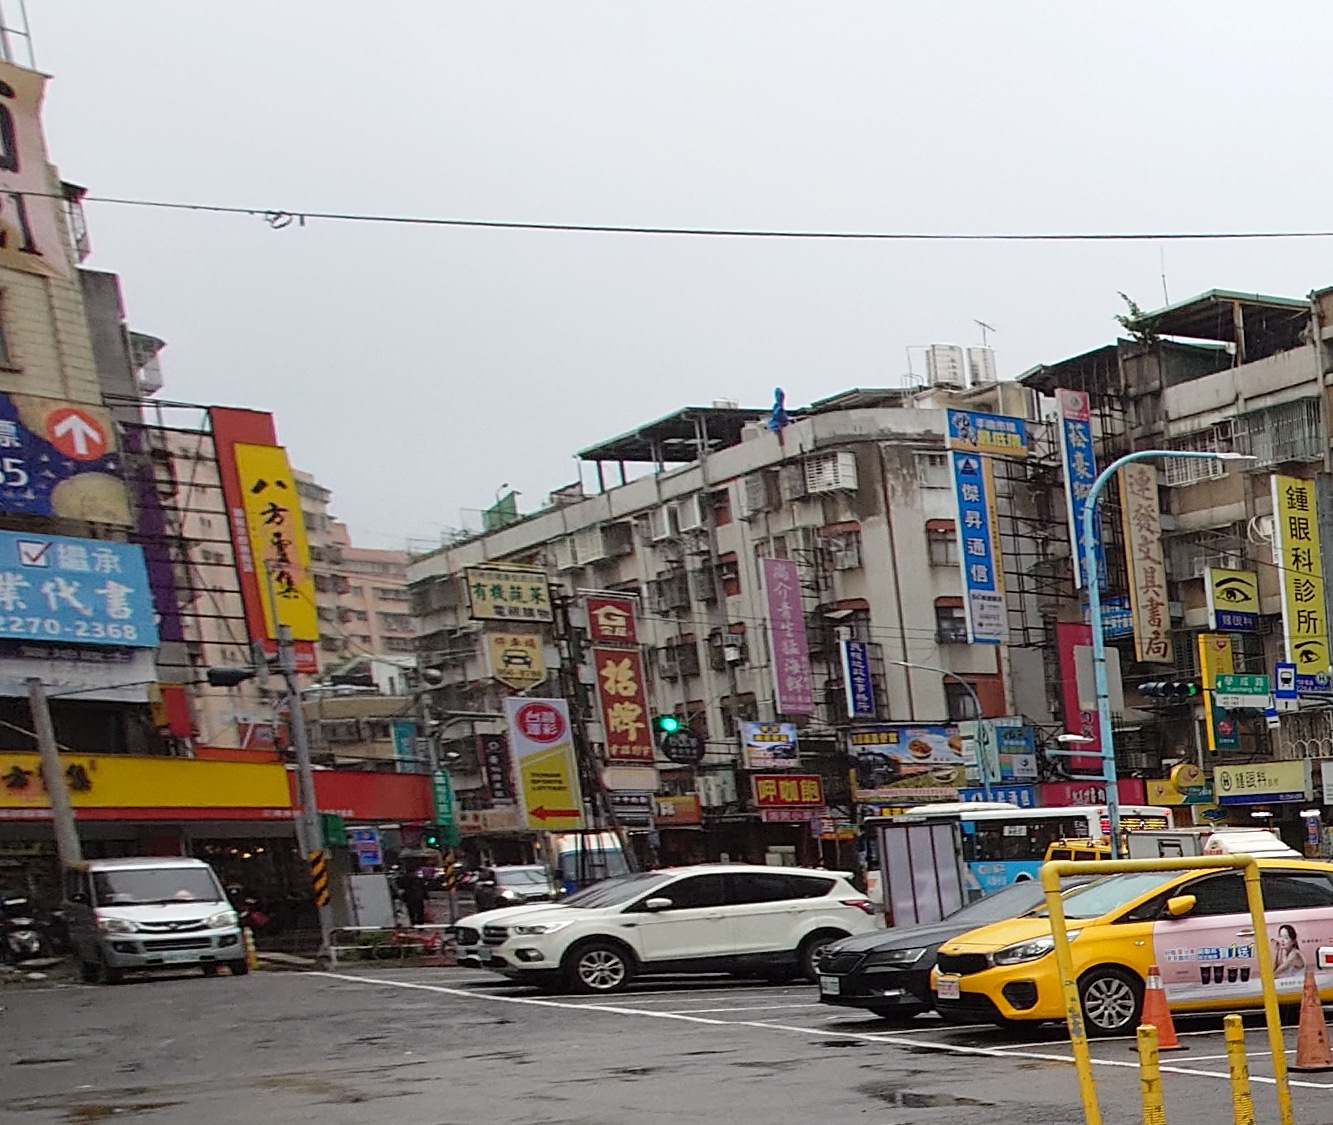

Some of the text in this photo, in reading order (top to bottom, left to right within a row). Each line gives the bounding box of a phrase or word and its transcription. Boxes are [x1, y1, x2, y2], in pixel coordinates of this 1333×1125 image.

[961, 484, 988, 583] 傑昇通信
[1286, 486, 1318, 634] 鍾眼科診所
[0, 616, 138, 640] 270-2368
[600, 657, 645, 742] 招牌
